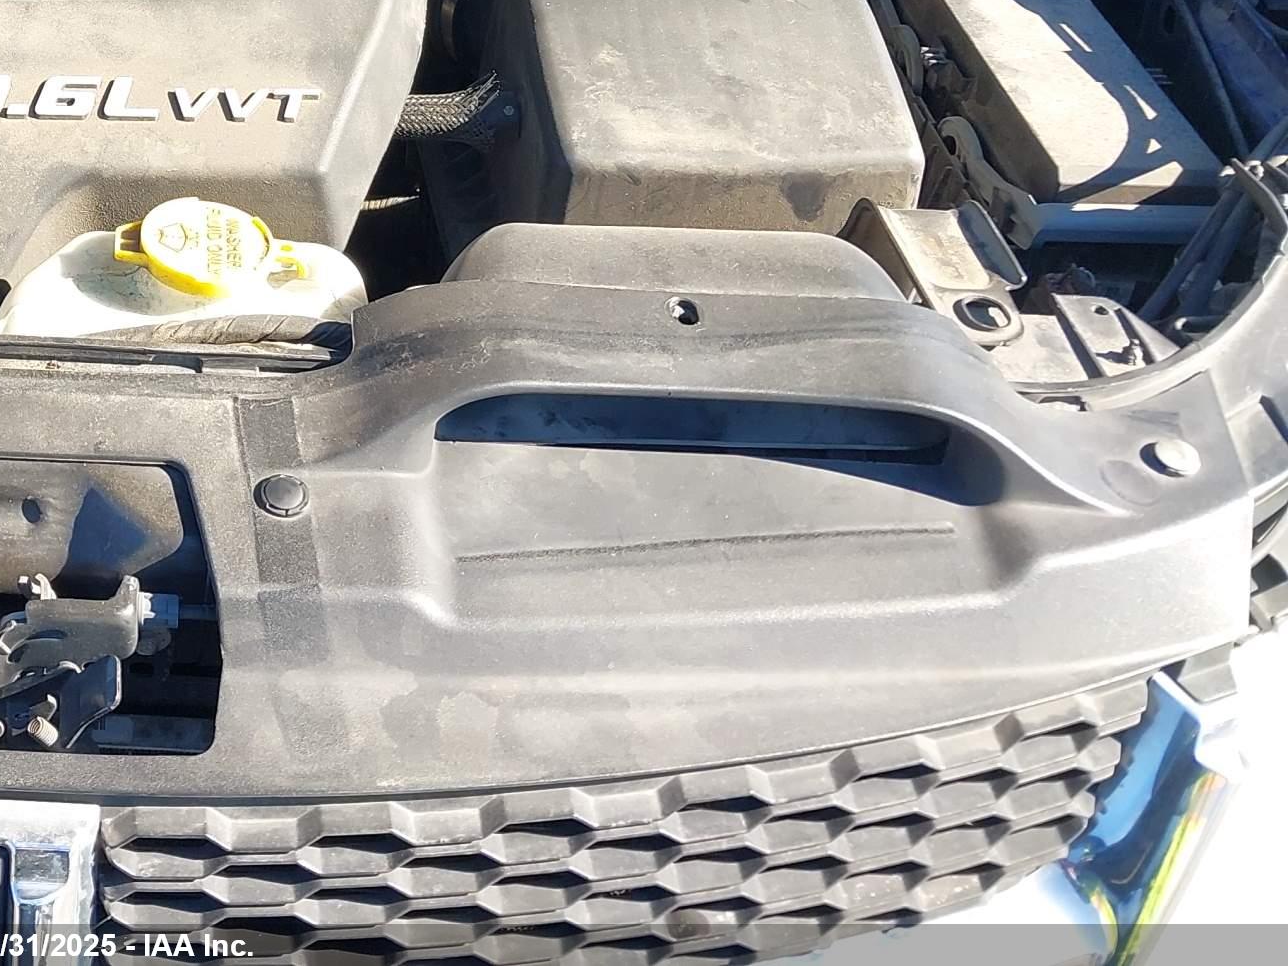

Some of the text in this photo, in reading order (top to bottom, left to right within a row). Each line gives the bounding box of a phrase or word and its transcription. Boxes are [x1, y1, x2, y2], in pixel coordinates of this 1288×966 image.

[167, 86, 322, 123] VVT
[205, 244, 222, 276] ONLY
[225, 218, 242, 269] WASHER
